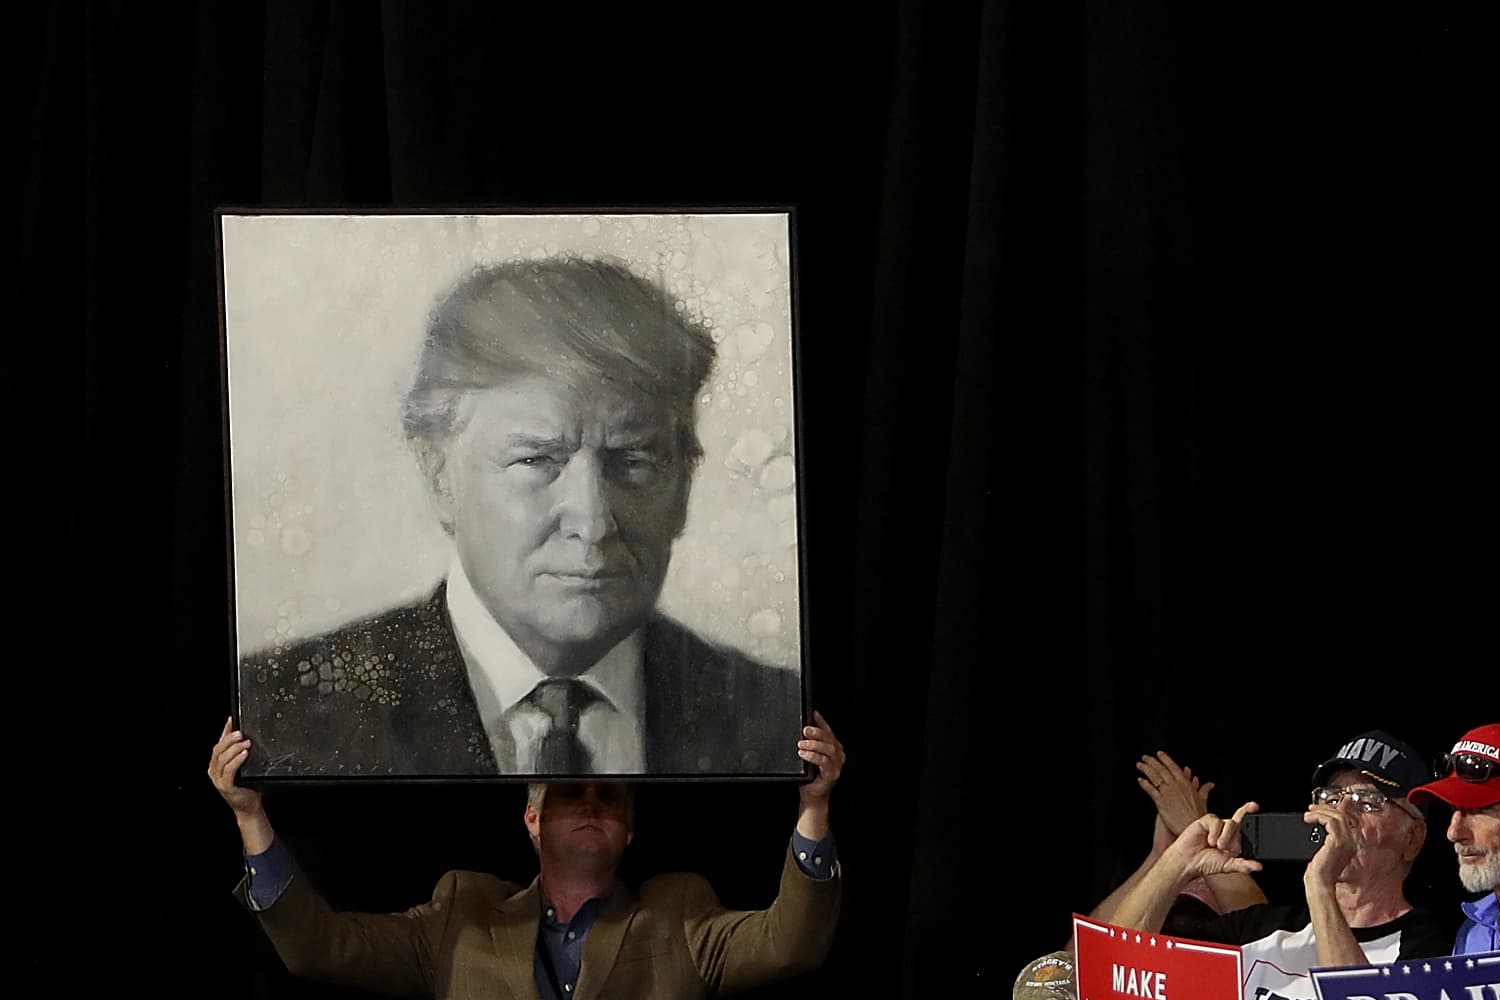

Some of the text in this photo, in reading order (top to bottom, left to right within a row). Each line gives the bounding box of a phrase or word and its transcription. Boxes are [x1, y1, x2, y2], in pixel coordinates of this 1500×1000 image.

[1336, 738, 1399, 771] NAVY
[1461, 741, 1500, 760] AMERICA
[1112, 963, 1167, 1000] MAKE
